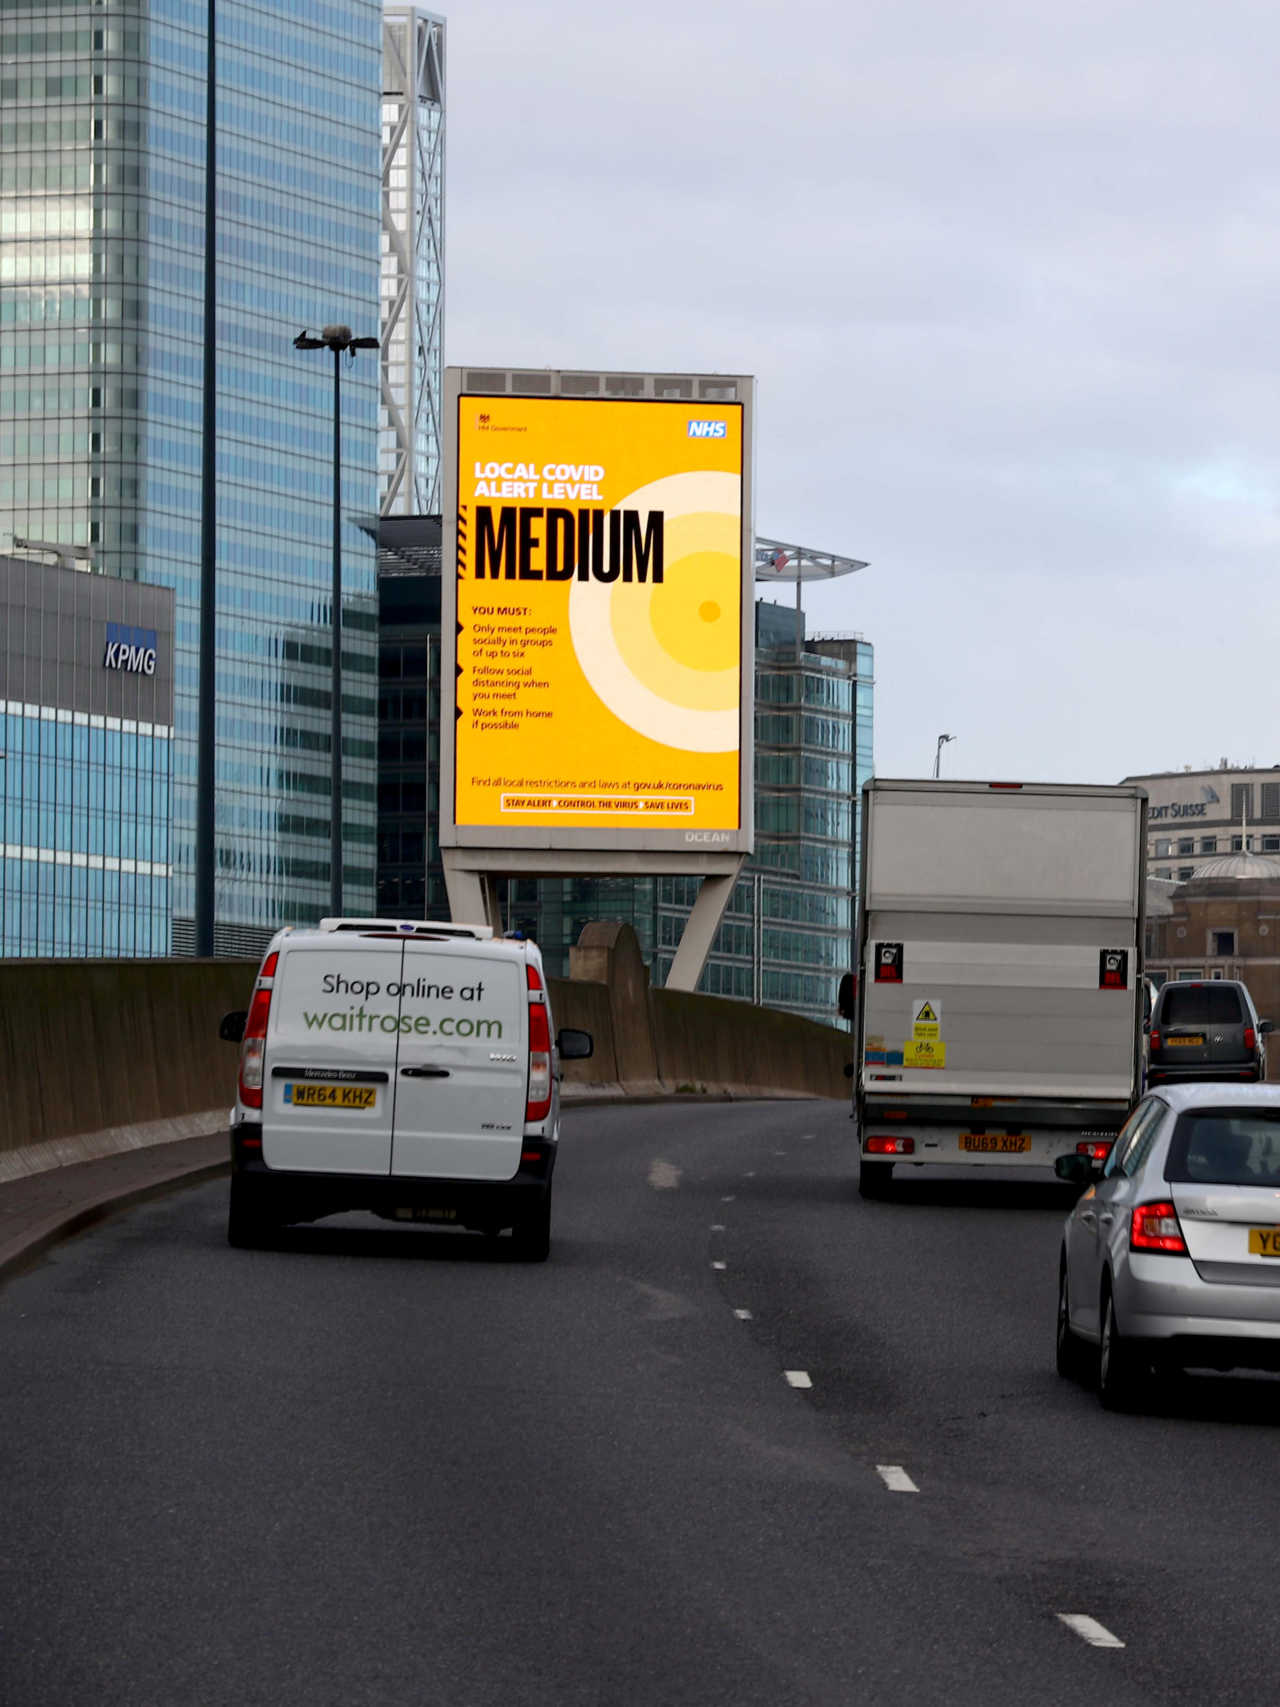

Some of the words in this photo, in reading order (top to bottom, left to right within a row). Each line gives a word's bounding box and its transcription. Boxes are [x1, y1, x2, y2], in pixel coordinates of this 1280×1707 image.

[690, 421, 725, 437] NHS
[474, 461, 540, 480] LOCAL
[542, 463, 605, 482] COVID
[474, 480, 538, 498] ALERT
[542, 482, 603, 500] LEVEL
[475, 506, 664, 583] MEDIUM
[472, 606, 494, 616] YOU
[497, 607, 532, 616] MUST:
[473, 624, 495, 634] Only
[497, 625, 522, 633] meet
[525, 626, 557, 635] people
[473, 637, 507, 647] socially
[520, 639, 553, 647] groups
[105, 641, 156, 675] KPMG
[473, 648, 483, 657] of
[486, 650, 498, 659] up
[501, 649, 510, 657] to
[512, 649, 525, 657] six
[473, 666, 504, 675] Follow
[507, 667, 532, 676] social
[473, 678, 520, 689] distancing
[523, 680, 550, 688] when
[473, 692, 490, 700] you
[473, 708, 497, 717] Work
[501, 708, 523, 717] from
[526, 708, 553, 718] home
[473, 720, 479, 728] if
[481, 721, 519, 730] possible
[472, 776, 491, 787] Find
[492, 777, 502, 787] all
[504, 777, 524, 788] local
[525, 778, 577, 788] restrictions
[579, 779, 596, 789] and
[599, 780, 619, 789] laws
[621, 780, 630, 789] at
[634, 780, 724, 792] gov.uk/coronavirus
[506, 799, 525, 807] STAY
[527, 799, 552, 807] ALERT
[558, 800, 596, 808] CONTROL
[599, 800, 612, 808] THE
[614, 801, 639, 809] VIRUS
[644, 801, 665, 809] SAVE
[666, 801, 689, 810] LIVES
[1171, 802, 1207, 818] SUISSE
[685, 832, 730, 843] OCEAN
[322, 974, 380, 1000] Shop
[386, 978, 454, 999] online
[460, 981, 484, 1001] at
[303, 1006, 503, 1038] waitrose.com
[296, 1085, 337, 1103] WR64
[342, 1087, 374, 1105] KHZ
